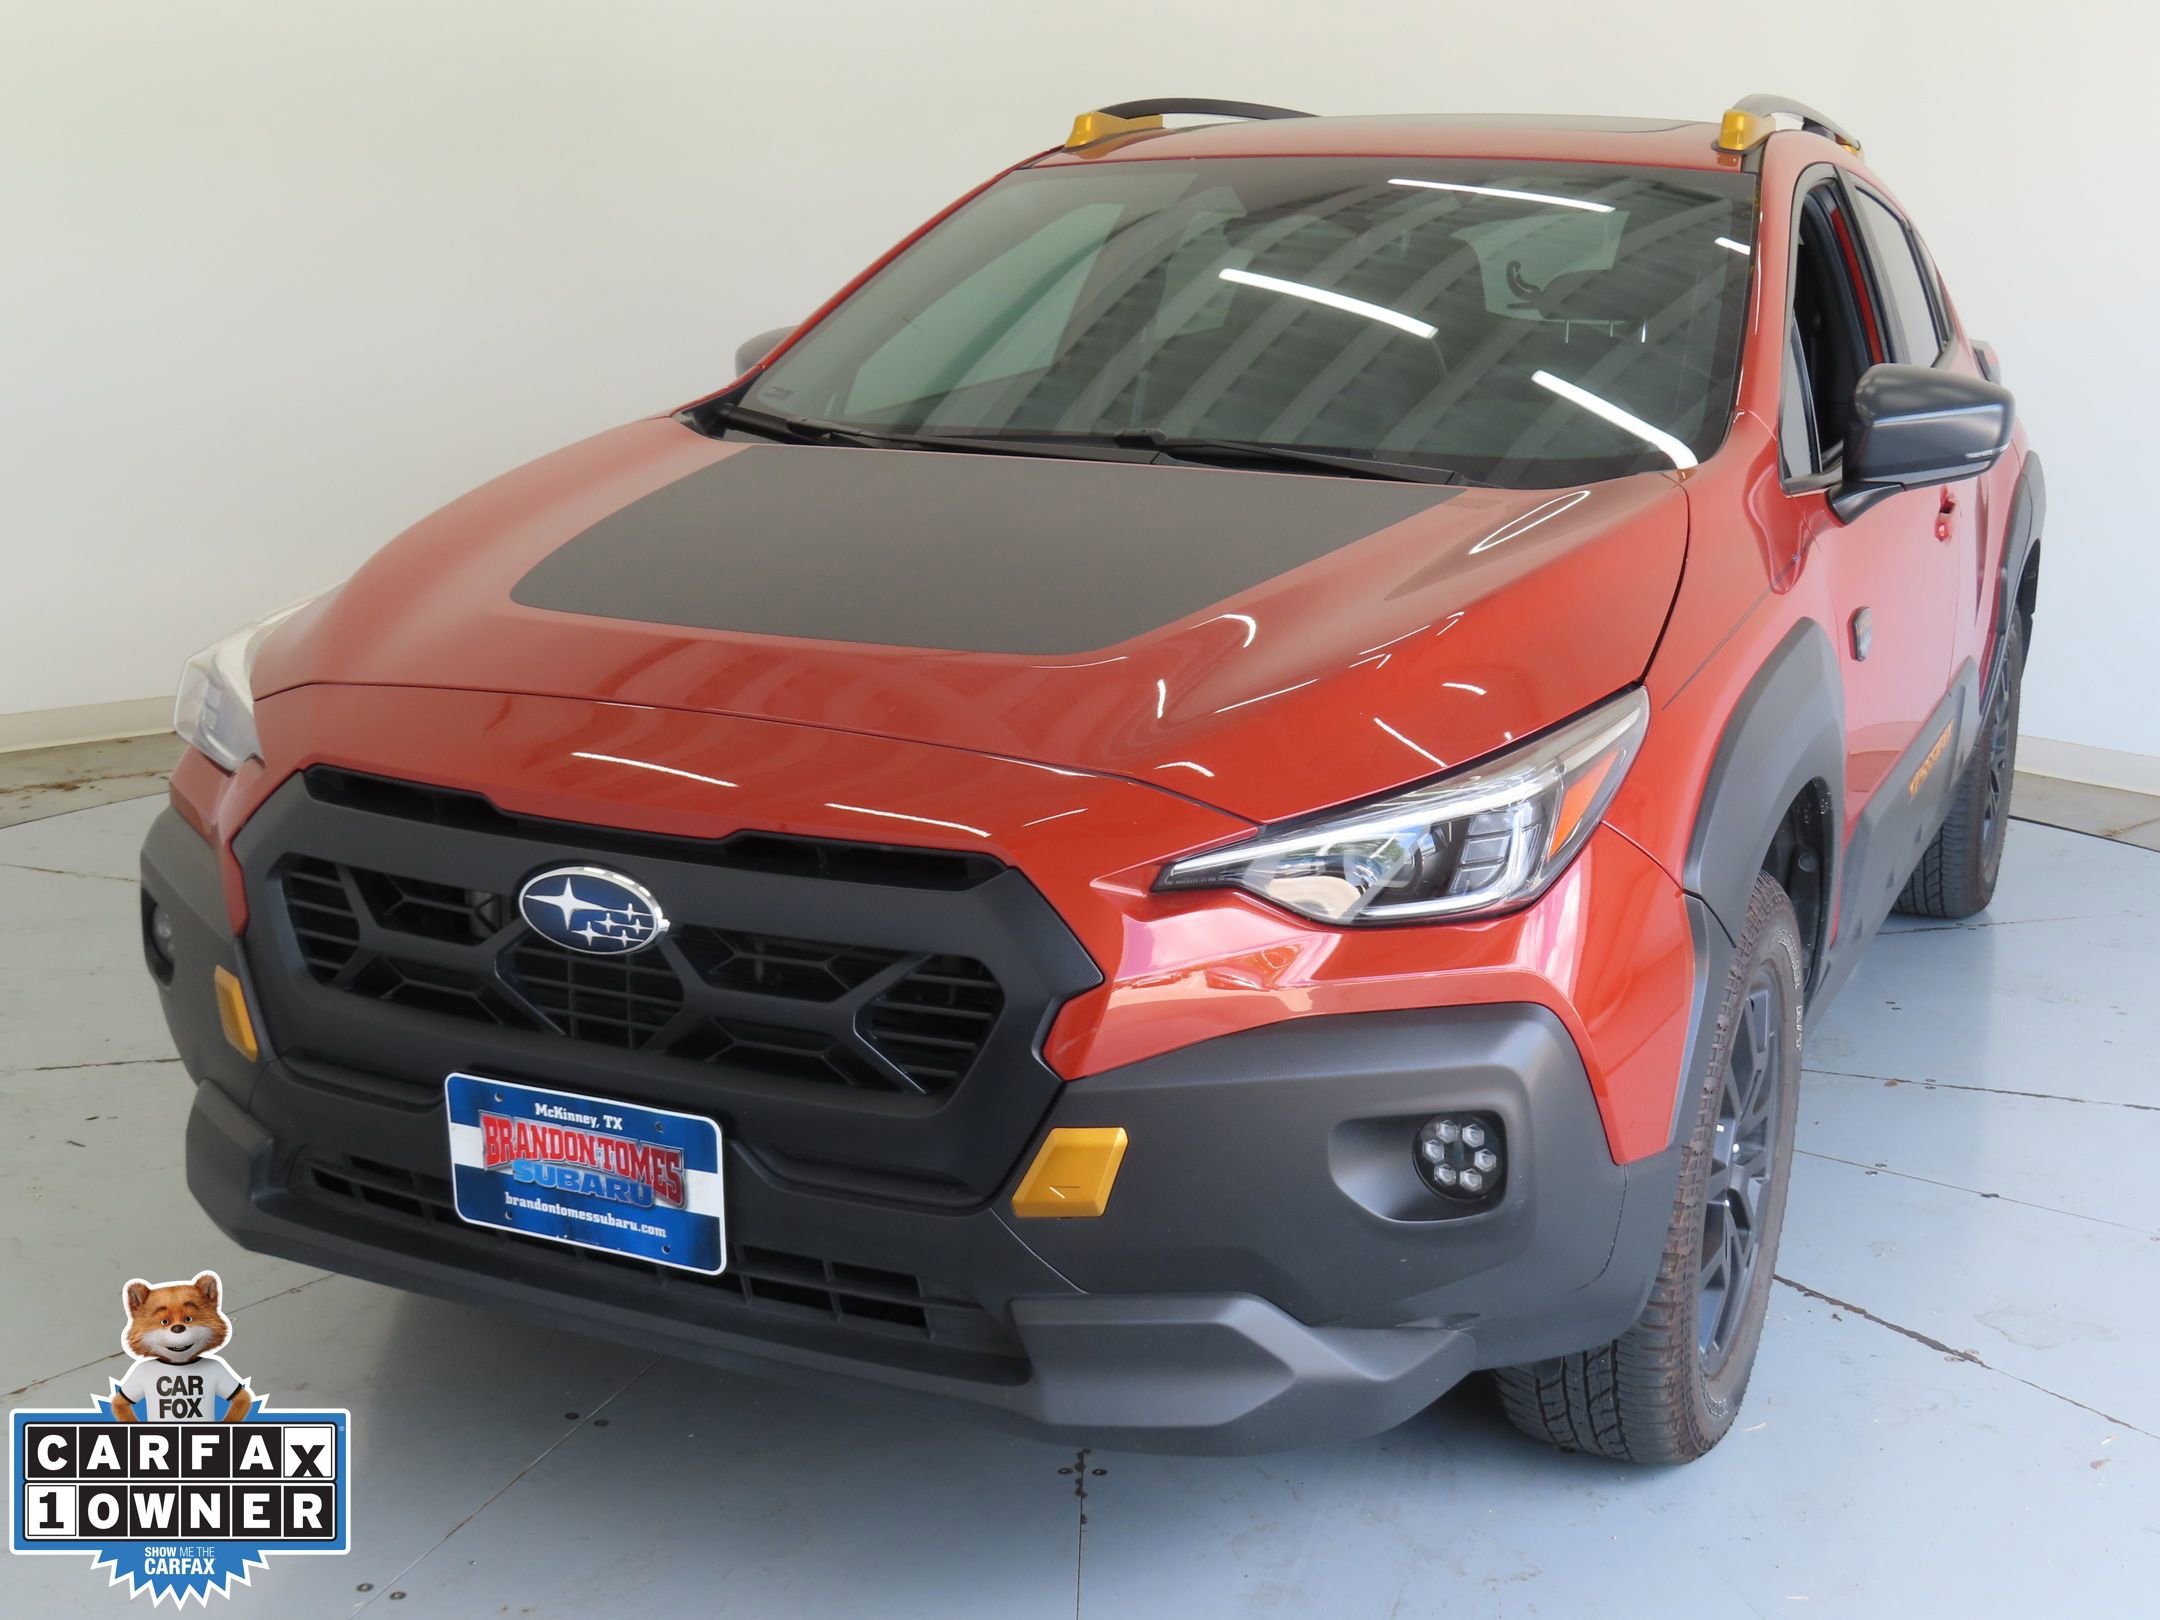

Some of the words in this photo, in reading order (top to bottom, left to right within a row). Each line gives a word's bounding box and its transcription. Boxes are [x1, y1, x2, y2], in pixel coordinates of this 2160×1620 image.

[535, 1103, 600, 1128] McKinney,
[603, 1114, 623, 1130] TX
[512, 1159, 653, 1207] SUBARU
[504, 1192, 667, 1239] brandontomessubaru.com
